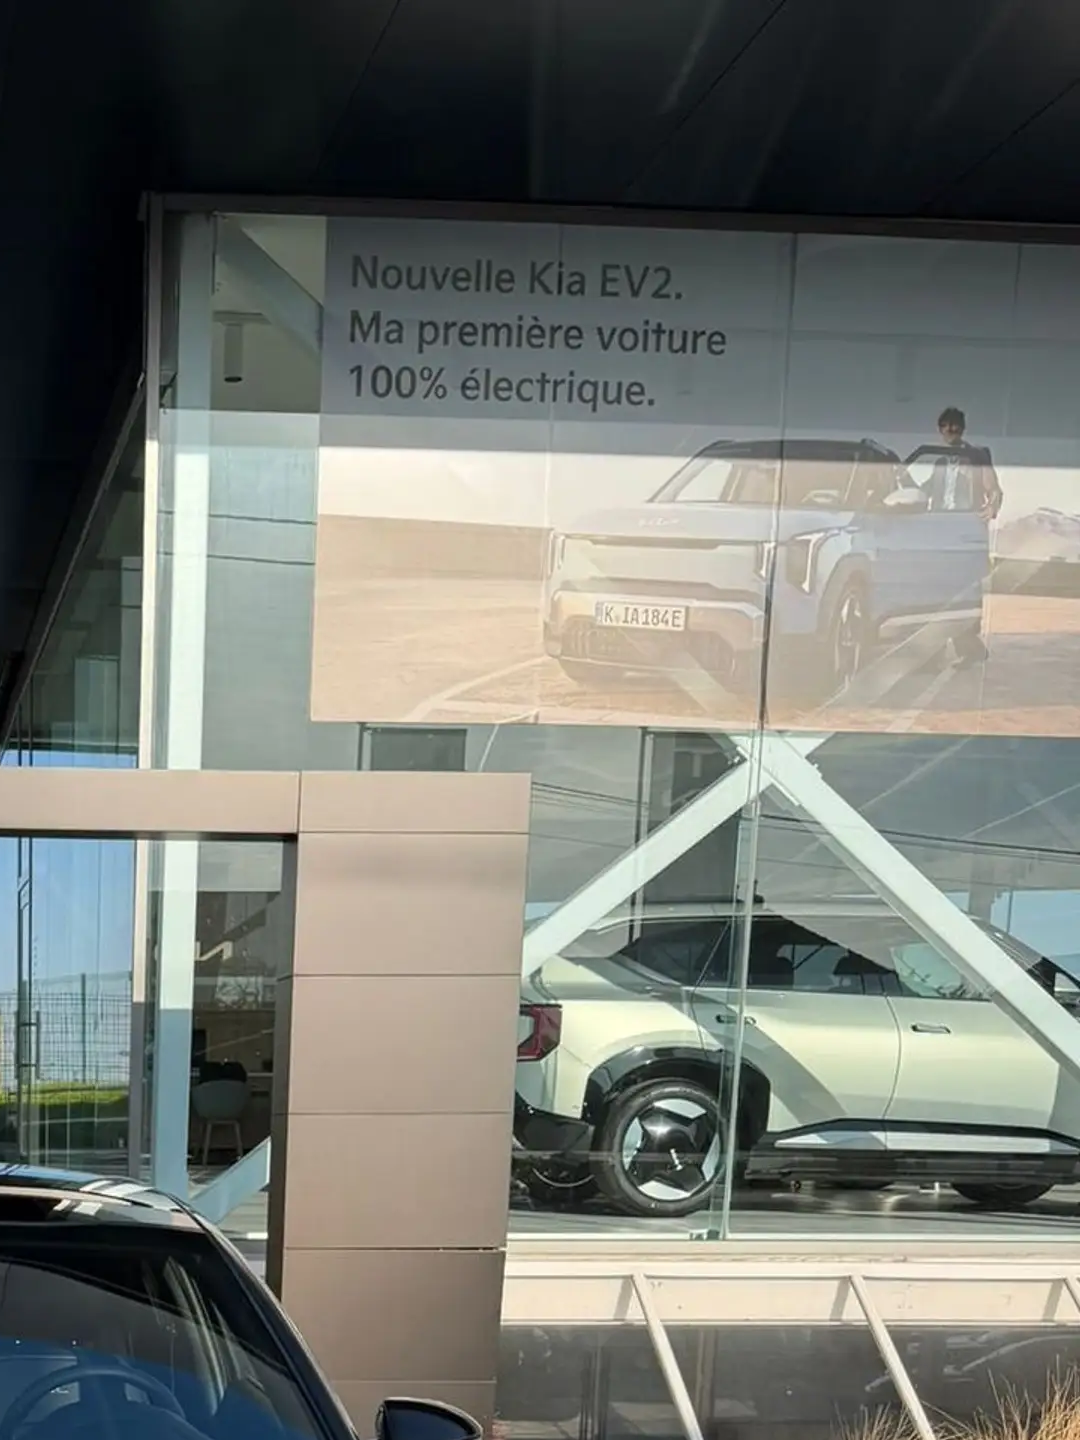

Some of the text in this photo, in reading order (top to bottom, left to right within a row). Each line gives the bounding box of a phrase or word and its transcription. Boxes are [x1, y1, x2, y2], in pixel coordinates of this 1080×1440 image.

[351, 255, 684, 300] Nouvelle Kia EV2.
[349, 309, 727, 356] Ma première voiture
[349, 364, 656, 413] 100% électrique.
